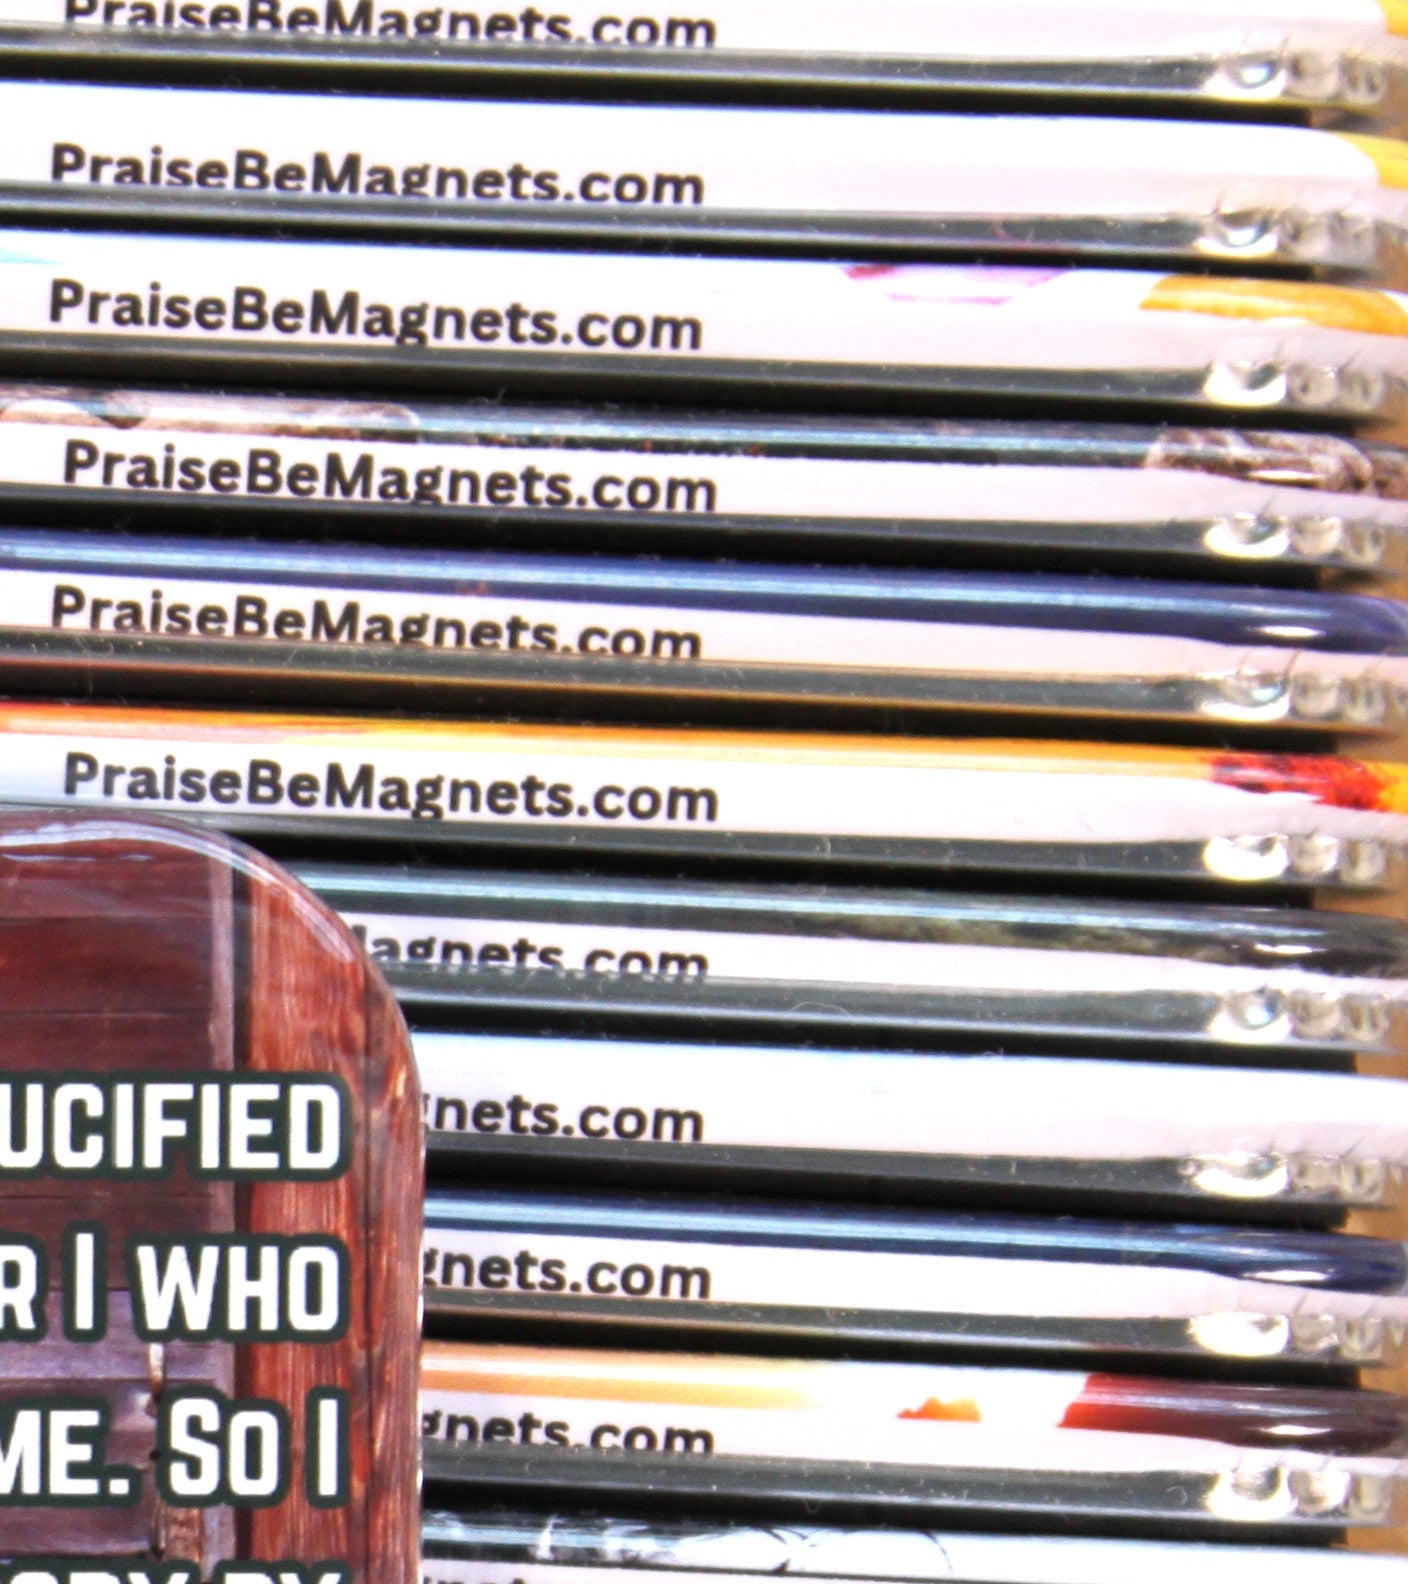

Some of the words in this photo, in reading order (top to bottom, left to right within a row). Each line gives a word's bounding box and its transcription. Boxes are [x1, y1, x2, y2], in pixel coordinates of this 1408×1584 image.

[51, 143, 705, 205] PraiseBeMagnets.com
[49, 279, 702, 350] PraiseBeMagnets.com
[64, 439, 716, 511] PraiseBeMagnets.com
[64, 752, 718, 822] PraiseBeMagnets.com
[75, 1232, 95, 1331] I
[136, 1244, 339, 1332] WHO
[318, 1398, 338, 1497] I
